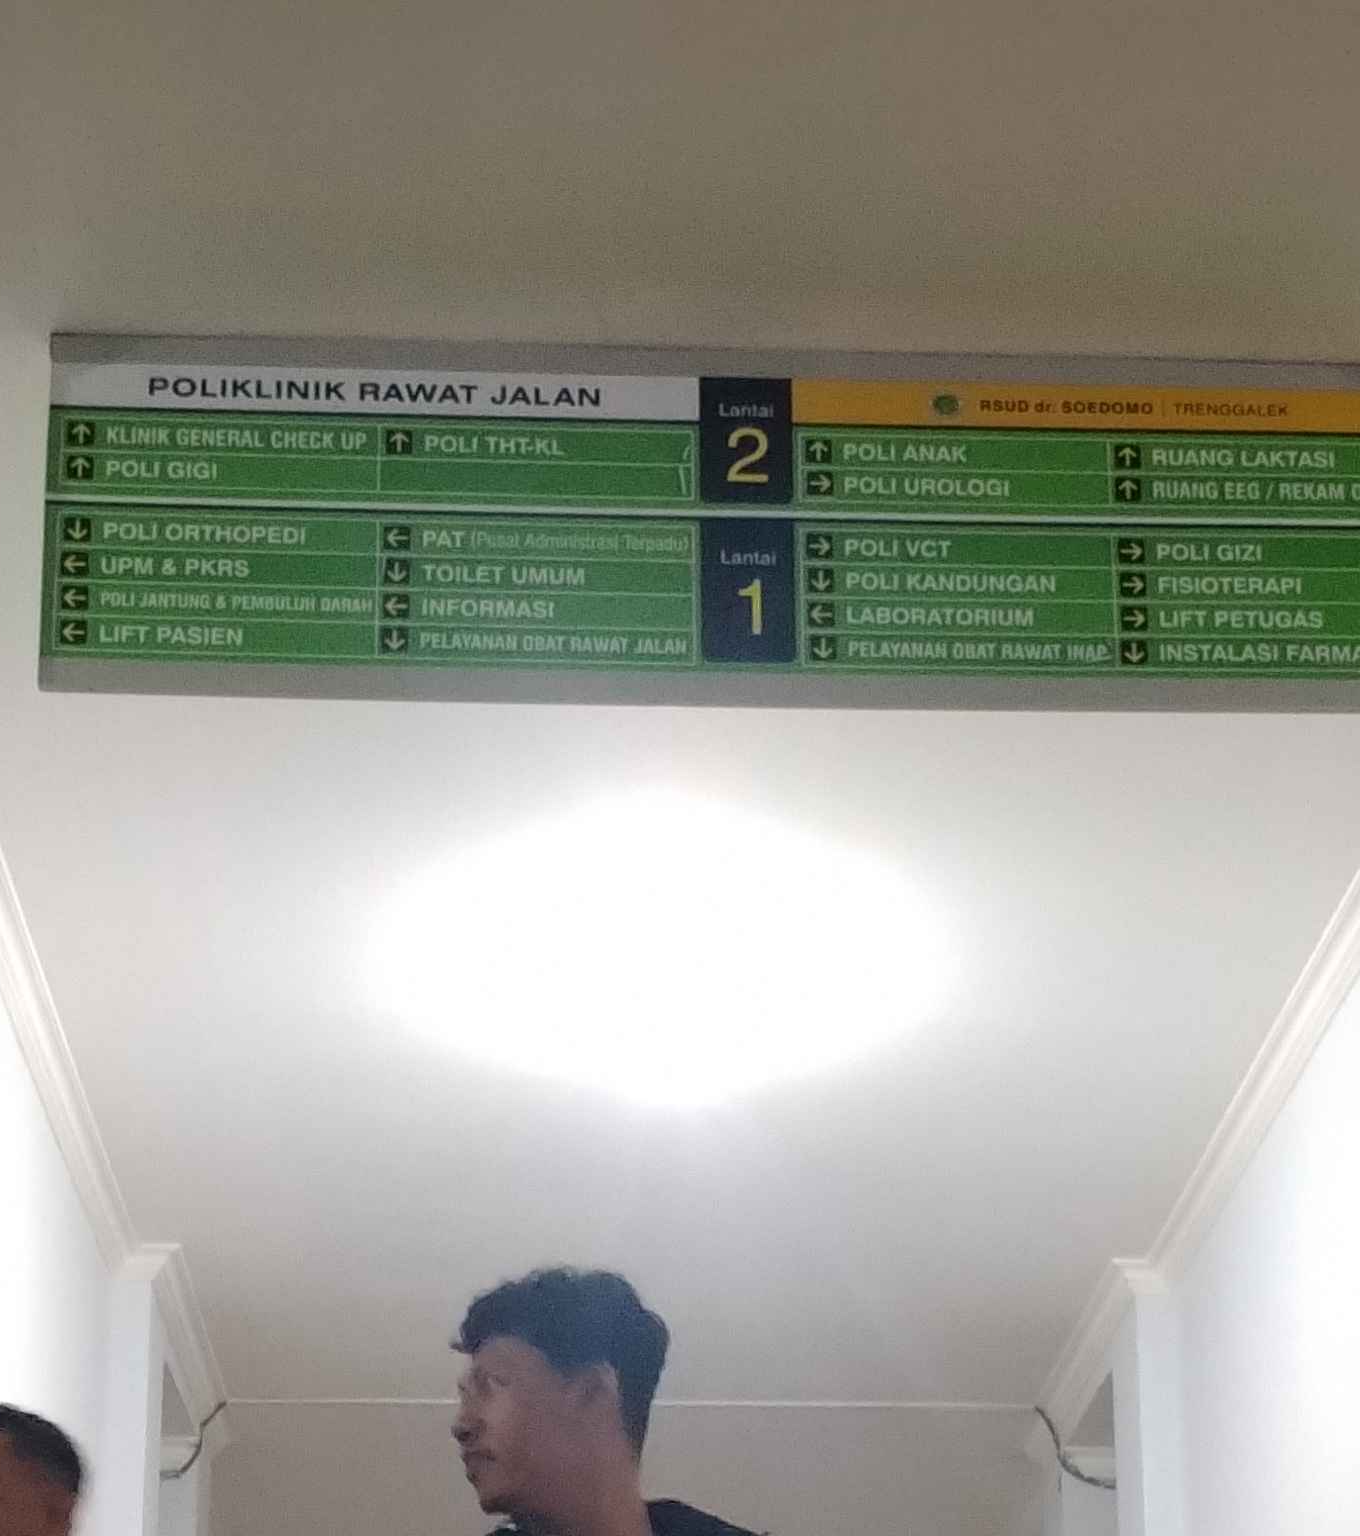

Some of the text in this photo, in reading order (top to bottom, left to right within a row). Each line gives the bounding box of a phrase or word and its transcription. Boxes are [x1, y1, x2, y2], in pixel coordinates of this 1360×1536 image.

[148, 377, 601, 407] POLIKLINIK RAWAT JALAN
[979, 399, 1029, 413] RSUD
[1061, 401, 1154, 415] SOEDOMO
[1173, 402, 1289, 418] TRENGGALEK
[106, 426, 367, 450] KLINIK GENERAL CHECK UP
[424, 434, 565, 456] POLI THT-KL
[726, 426, 769, 483] 2
[843, 444, 967, 463] POLI ANAK
[1151, 449, 1336, 469] RUANG LAKTASI
[105, 460, 218, 480] POLI GIGI
[844, 476, 1010, 497] POLI UROLOGI
[1152, 482, 1217, 500] RUANG
[1278, 484, 1345, 502] REKAM
[102, 521, 307, 545] POLI ORTHOPEDI
[422, 530, 465, 548] PAT
[720, 549, 777, 566] Lantai
[844, 539, 952, 558] POLI VCT
[1156, 543, 1263, 562] POLI GIZI
[100, 556, 251, 578] UPM & PKRS
[423, 564, 586, 586] TOILET UMUM
[844, 572, 1057, 594] POLI KANDUNGAN
[1157, 576, 1303, 595] FISIOTERAPI
[99, 590, 136, 608] POLI
[140, 591, 211, 610] JANTUNG
[421, 598, 555, 619] INFORMASI
[737, 579, 763, 635] 1
[845, 607, 1035, 628] LABORATORIUM
[1158, 610, 1324, 629] LIFT PETUGAS
[98, 624, 244, 646] LIFT PASIEN
[418, 632, 688, 656] PELAYANAN OBAT RAWAT JALAN
[847, 640, 947, 659] PELAYANAN
[952, 642, 997, 660] OBAT
[1000, 642, 1062, 661] RAWAT
[1158, 644, 1279, 663] INSTALASI
